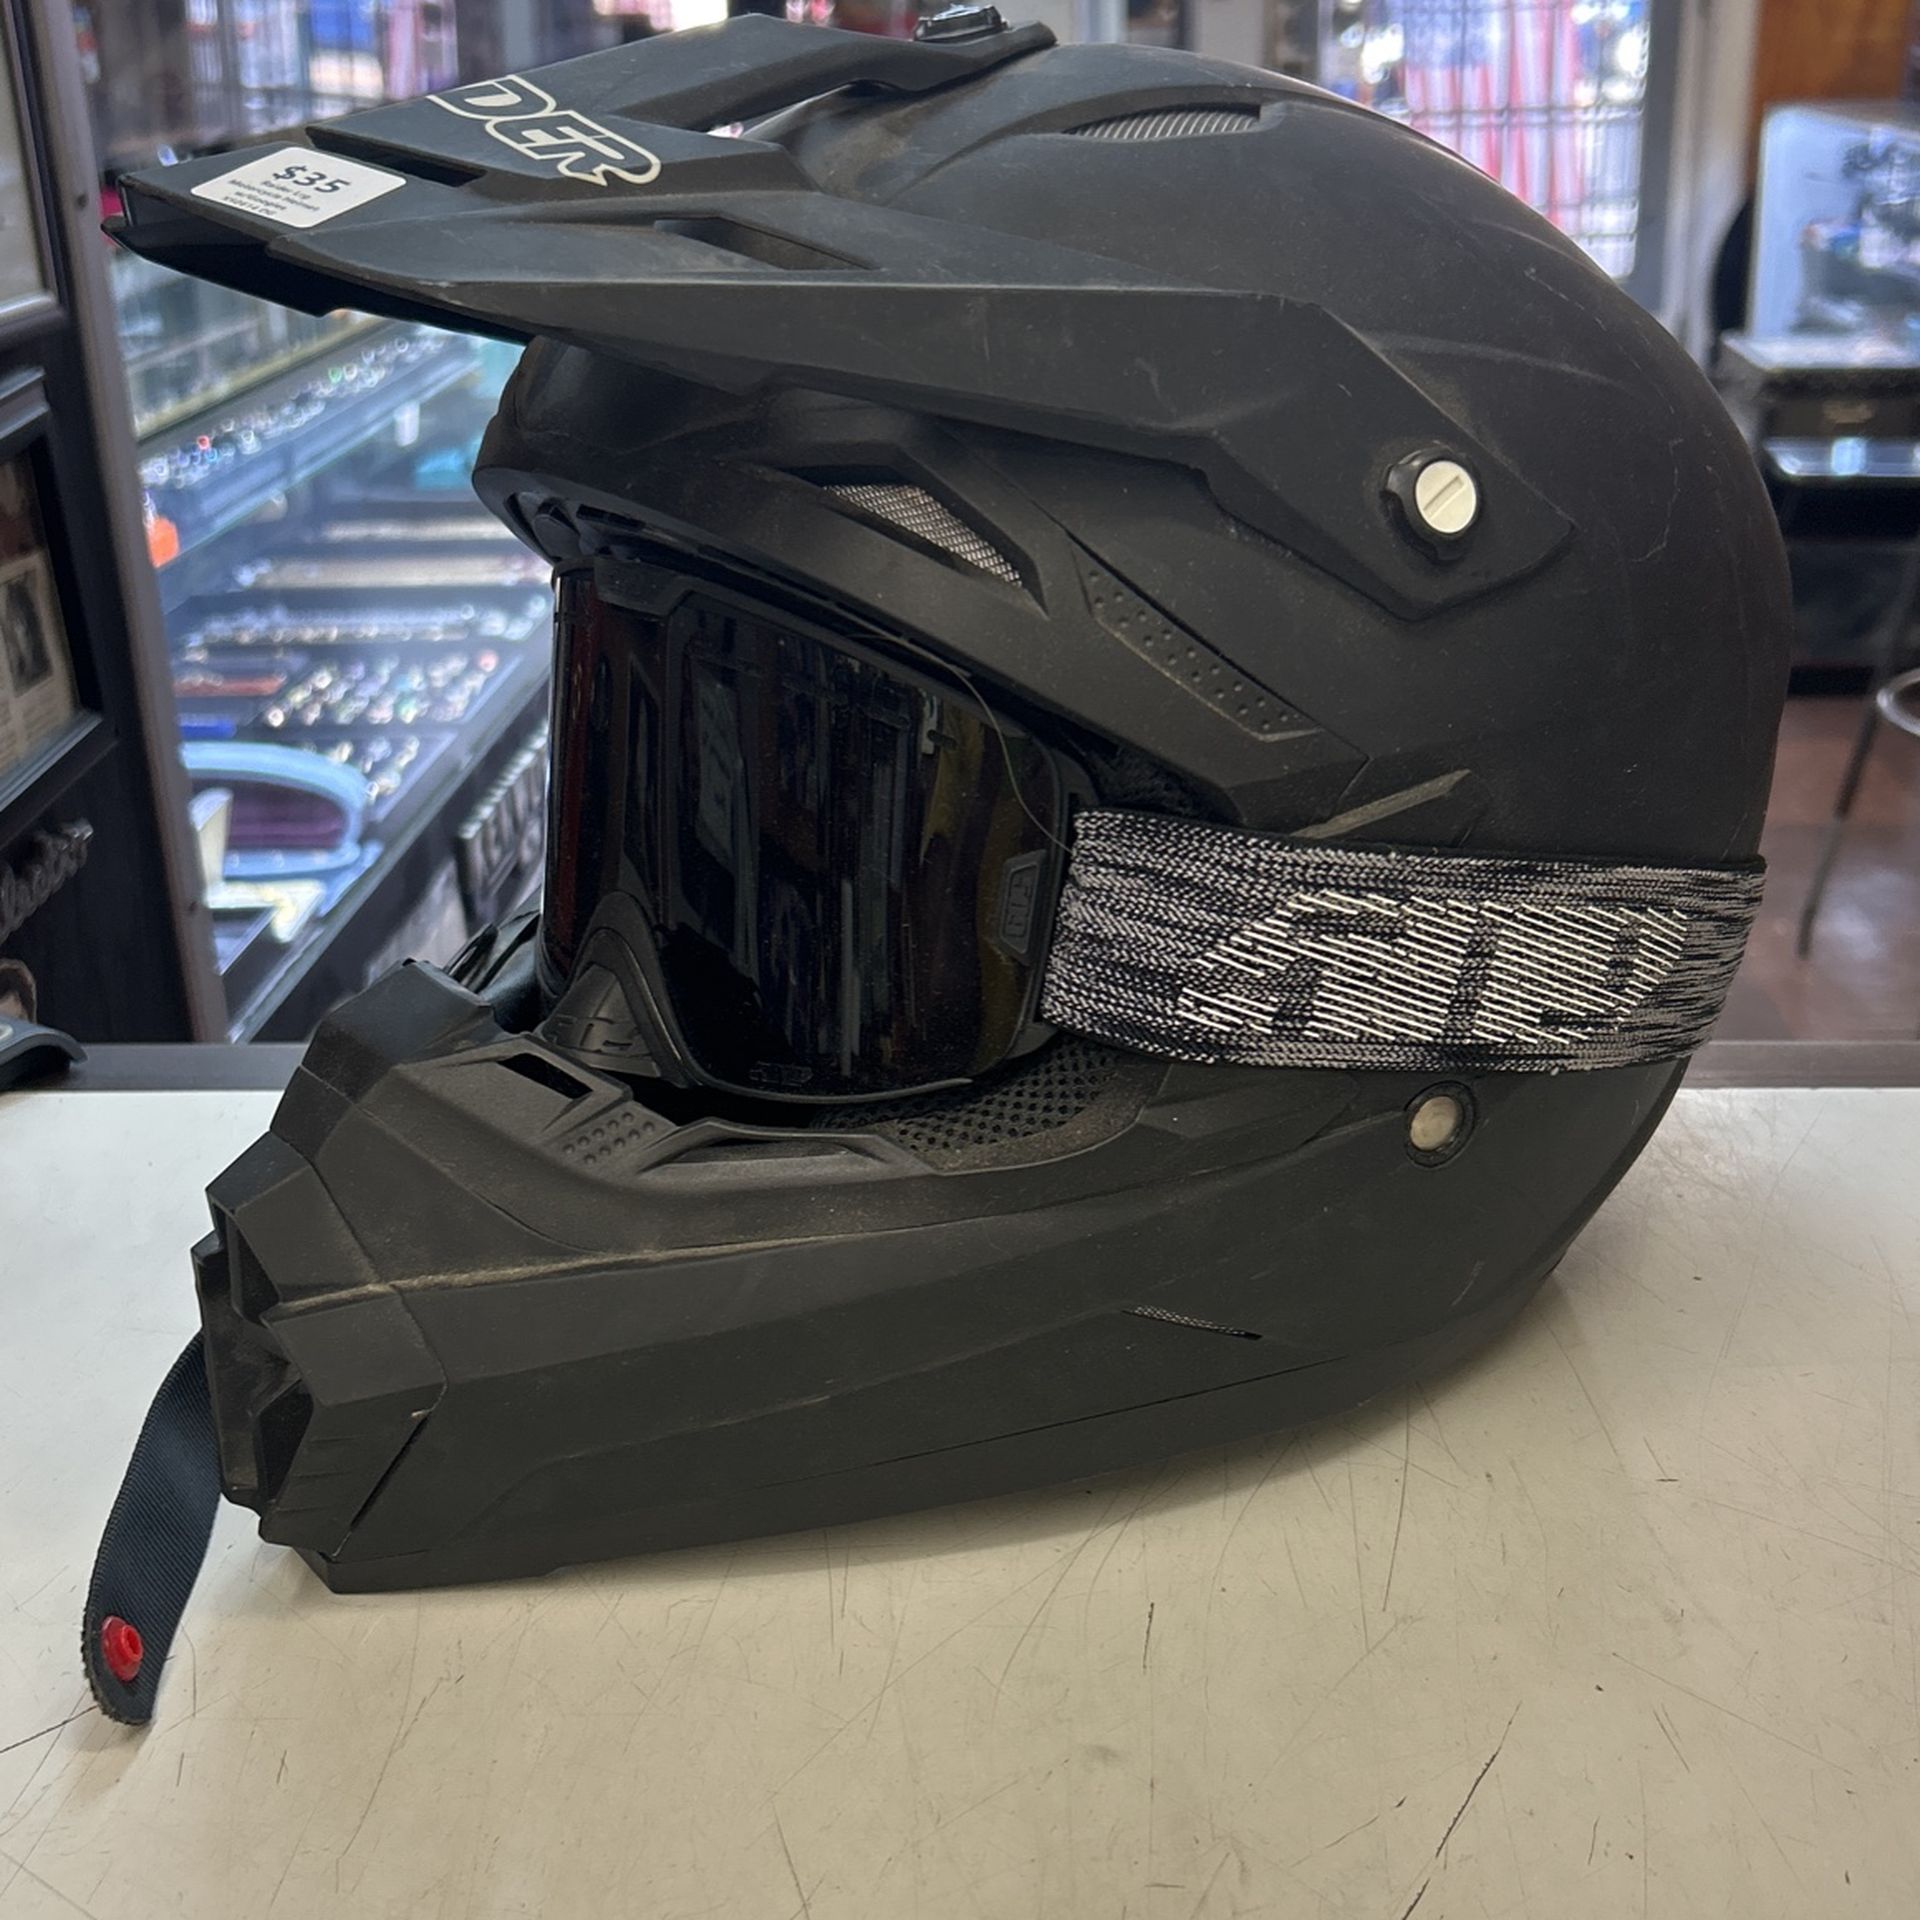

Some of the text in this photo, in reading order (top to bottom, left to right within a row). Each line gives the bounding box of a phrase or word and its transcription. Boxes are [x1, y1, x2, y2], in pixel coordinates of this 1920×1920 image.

[272, 165, 352, 194] $35
[228, 179, 320, 211] Motorcycle Helmet
